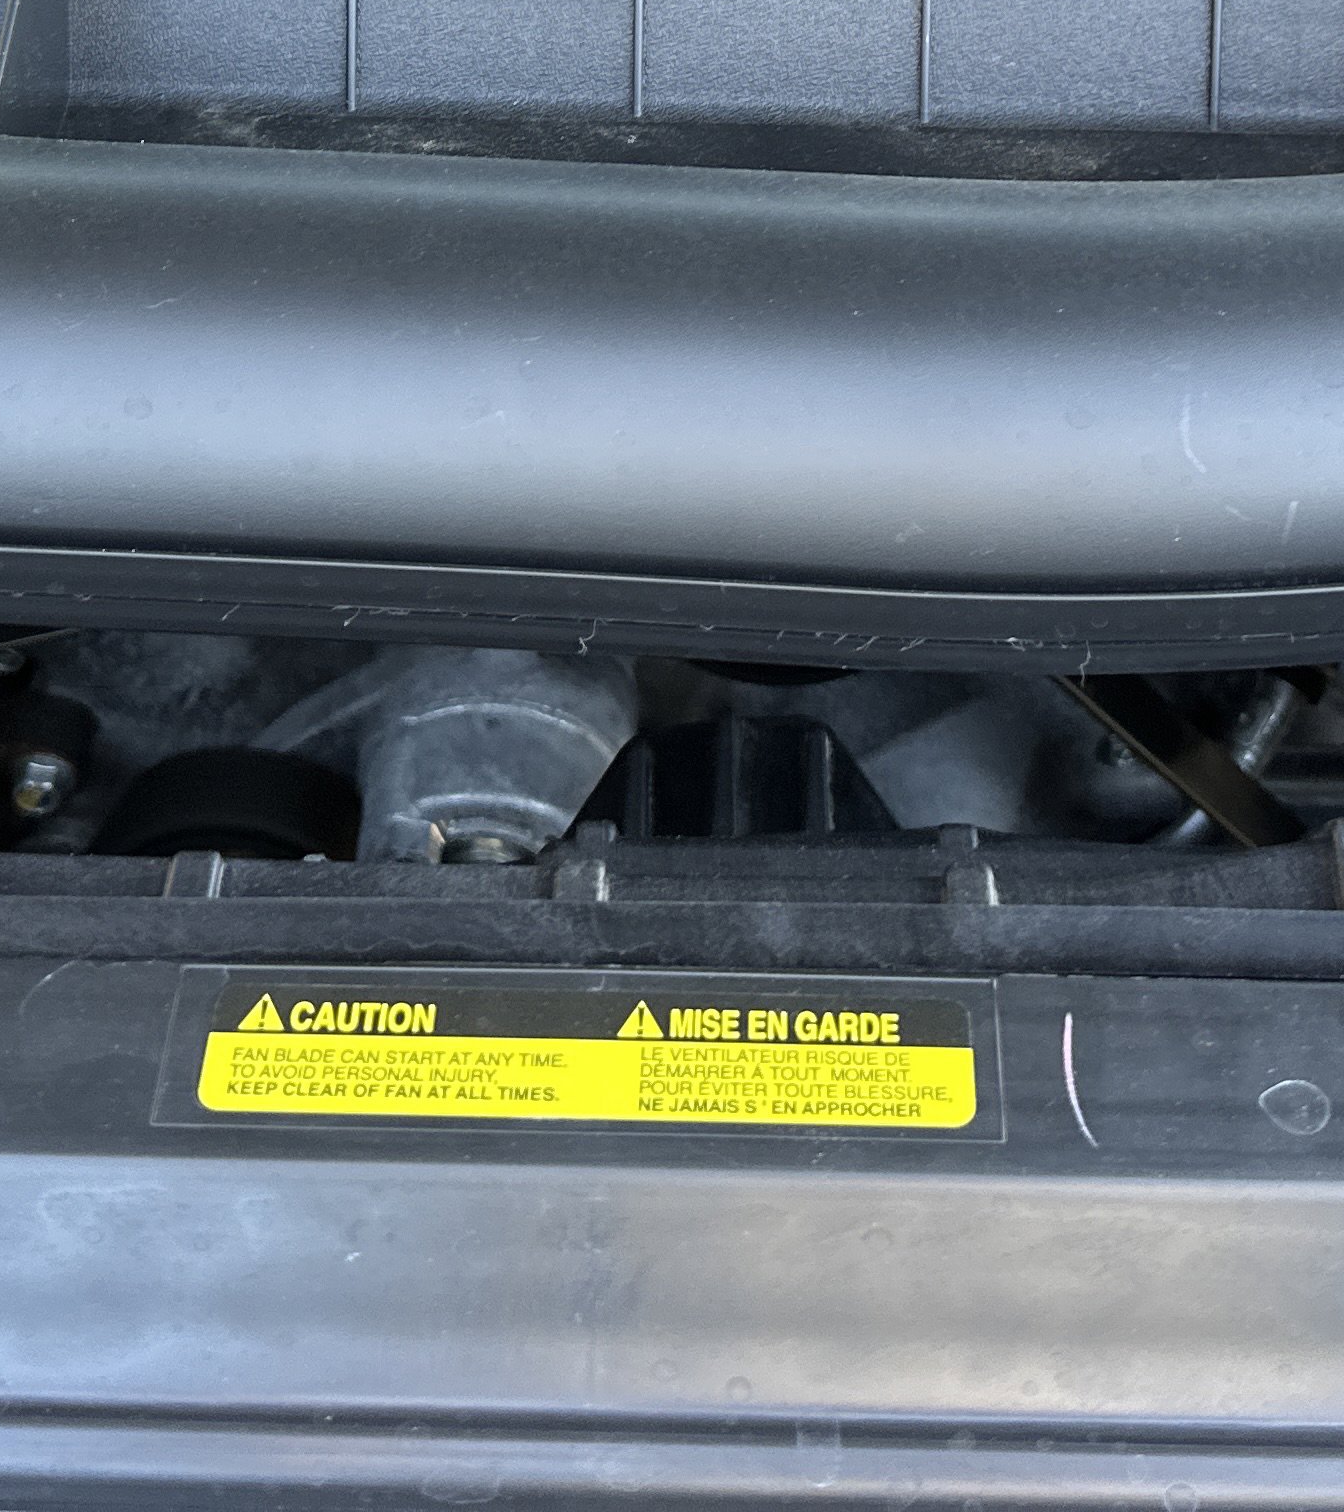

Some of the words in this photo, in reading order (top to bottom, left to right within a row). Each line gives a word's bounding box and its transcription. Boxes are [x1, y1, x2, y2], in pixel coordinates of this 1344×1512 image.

[288, 1000, 437, 1034] CAUTION
[669, 1007, 741, 1040] MISE
[747, 1009, 789, 1041] EN
[794, 1010, 901, 1044] GARDE
[232, 1046, 270, 1062] FAN
[273, 1047, 336, 1064] BLADE
[340, 1048, 381, 1064] CAN
[385, 1049, 447, 1065] START
[448, 1051, 473, 1066] AT
[474, 1052, 515, 1067] ANY
[640, 1046, 664, 1062] LE
[670, 1047, 800, 1064] VENTILATEUR
[805, 1049, 879, 1066] RISQUE
[884, 1051, 911, 1067] DE
[230, 1063, 256, 1079] TO
[258, 1064, 317, 1080] AVOID
[321, 1065, 424, 1081] PERSONAL
[640, 1059, 745, 1080] DÉMARRER
[769, 1065, 821, 1081] TOUT
[226, 1080, 278, 1096] KEEP
[282, 1081, 348, 1097] CLEAR
[353, 1083, 381, 1098] OF
[384, 1084, 423, 1099] FAN
[426, 1085, 452, 1099] AT
[454, 1086, 493, 1101] ALL
[497, 1086, 561, 1102] TIMES.
[639, 1079, 693, 1096] POUR
[698, 1076, 768, 1097] ÉVITER
[773, 1082, 838, 1098] TOUTE
[638, 1097, 665, 1112] NE
[668, 1098, 740, 1114] JAMAIS
[801, 1101, 922, 1118] APPROCHER
